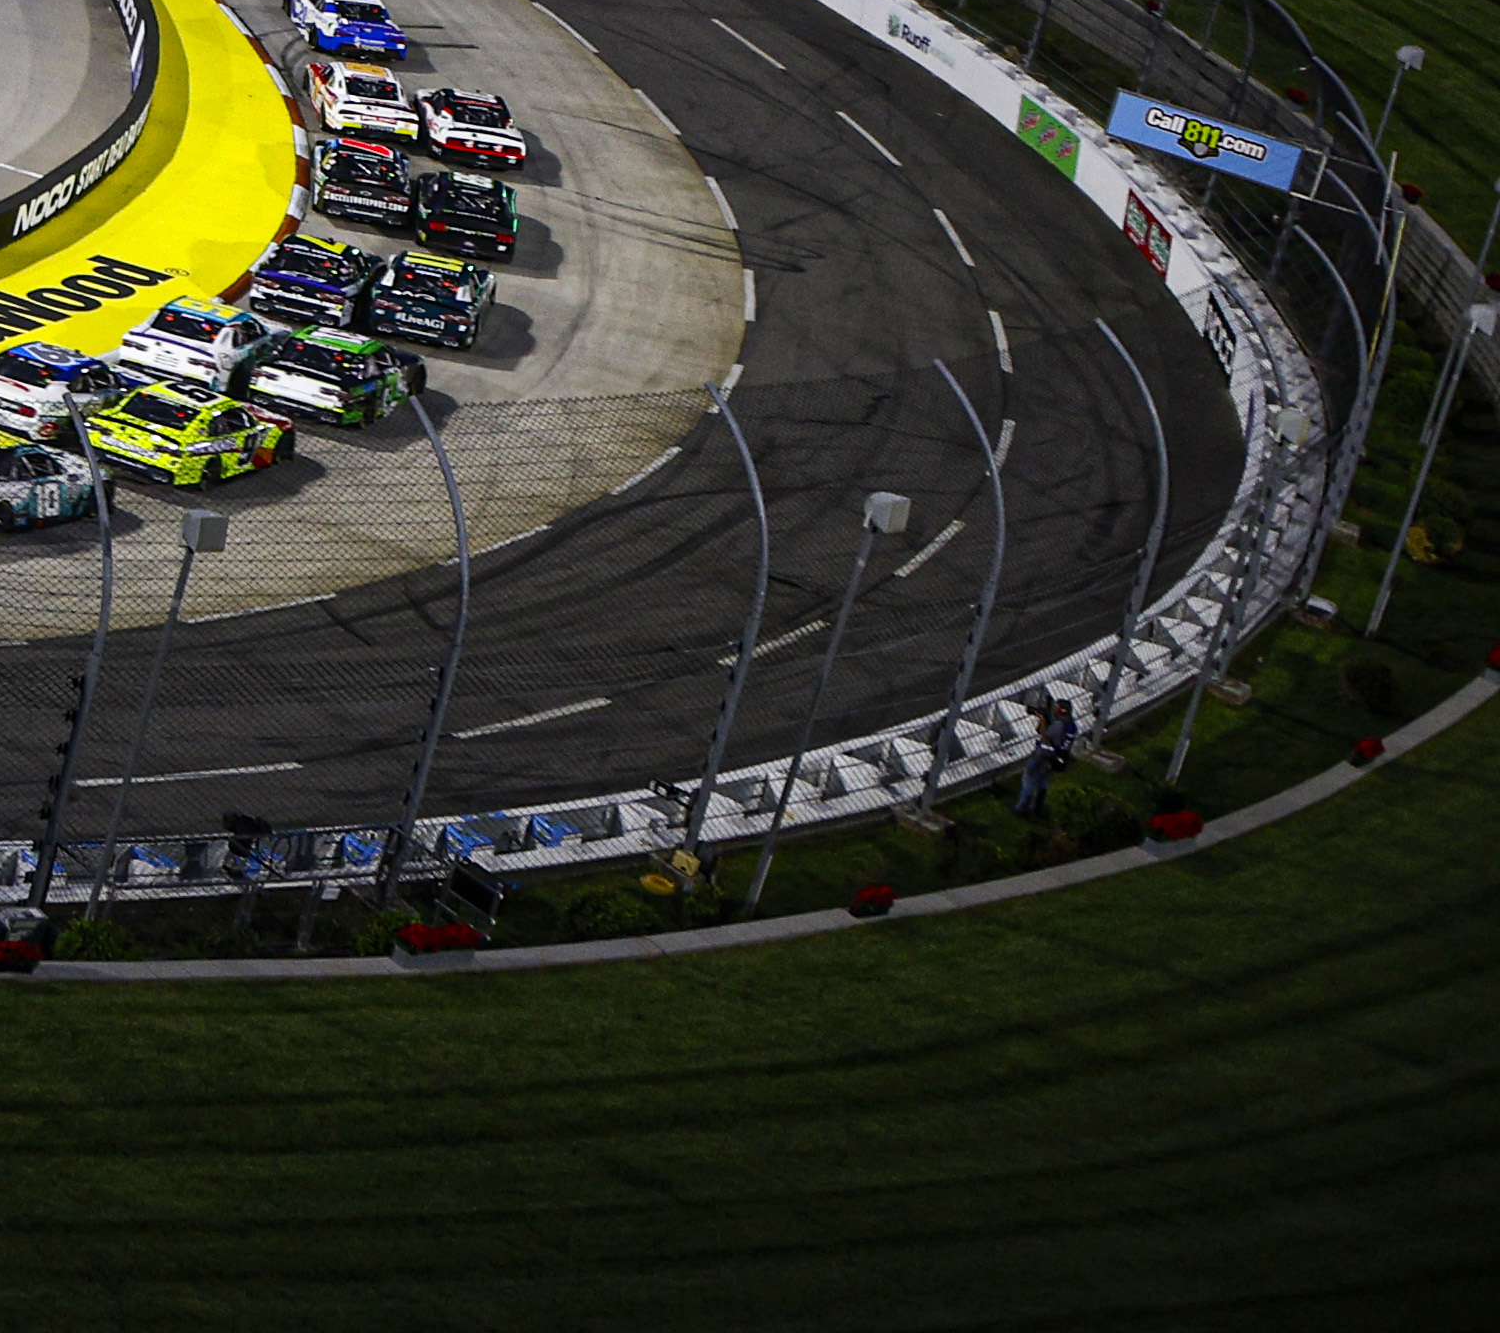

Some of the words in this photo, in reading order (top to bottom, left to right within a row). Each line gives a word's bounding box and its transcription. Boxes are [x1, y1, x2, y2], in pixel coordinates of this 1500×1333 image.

[902, 23, 932, 54] Ruoff
[1146, 108, 1267, 161] Call811.com
[13, 174, 76, 237] NOCO
[35, 481, 60, 519] 10
